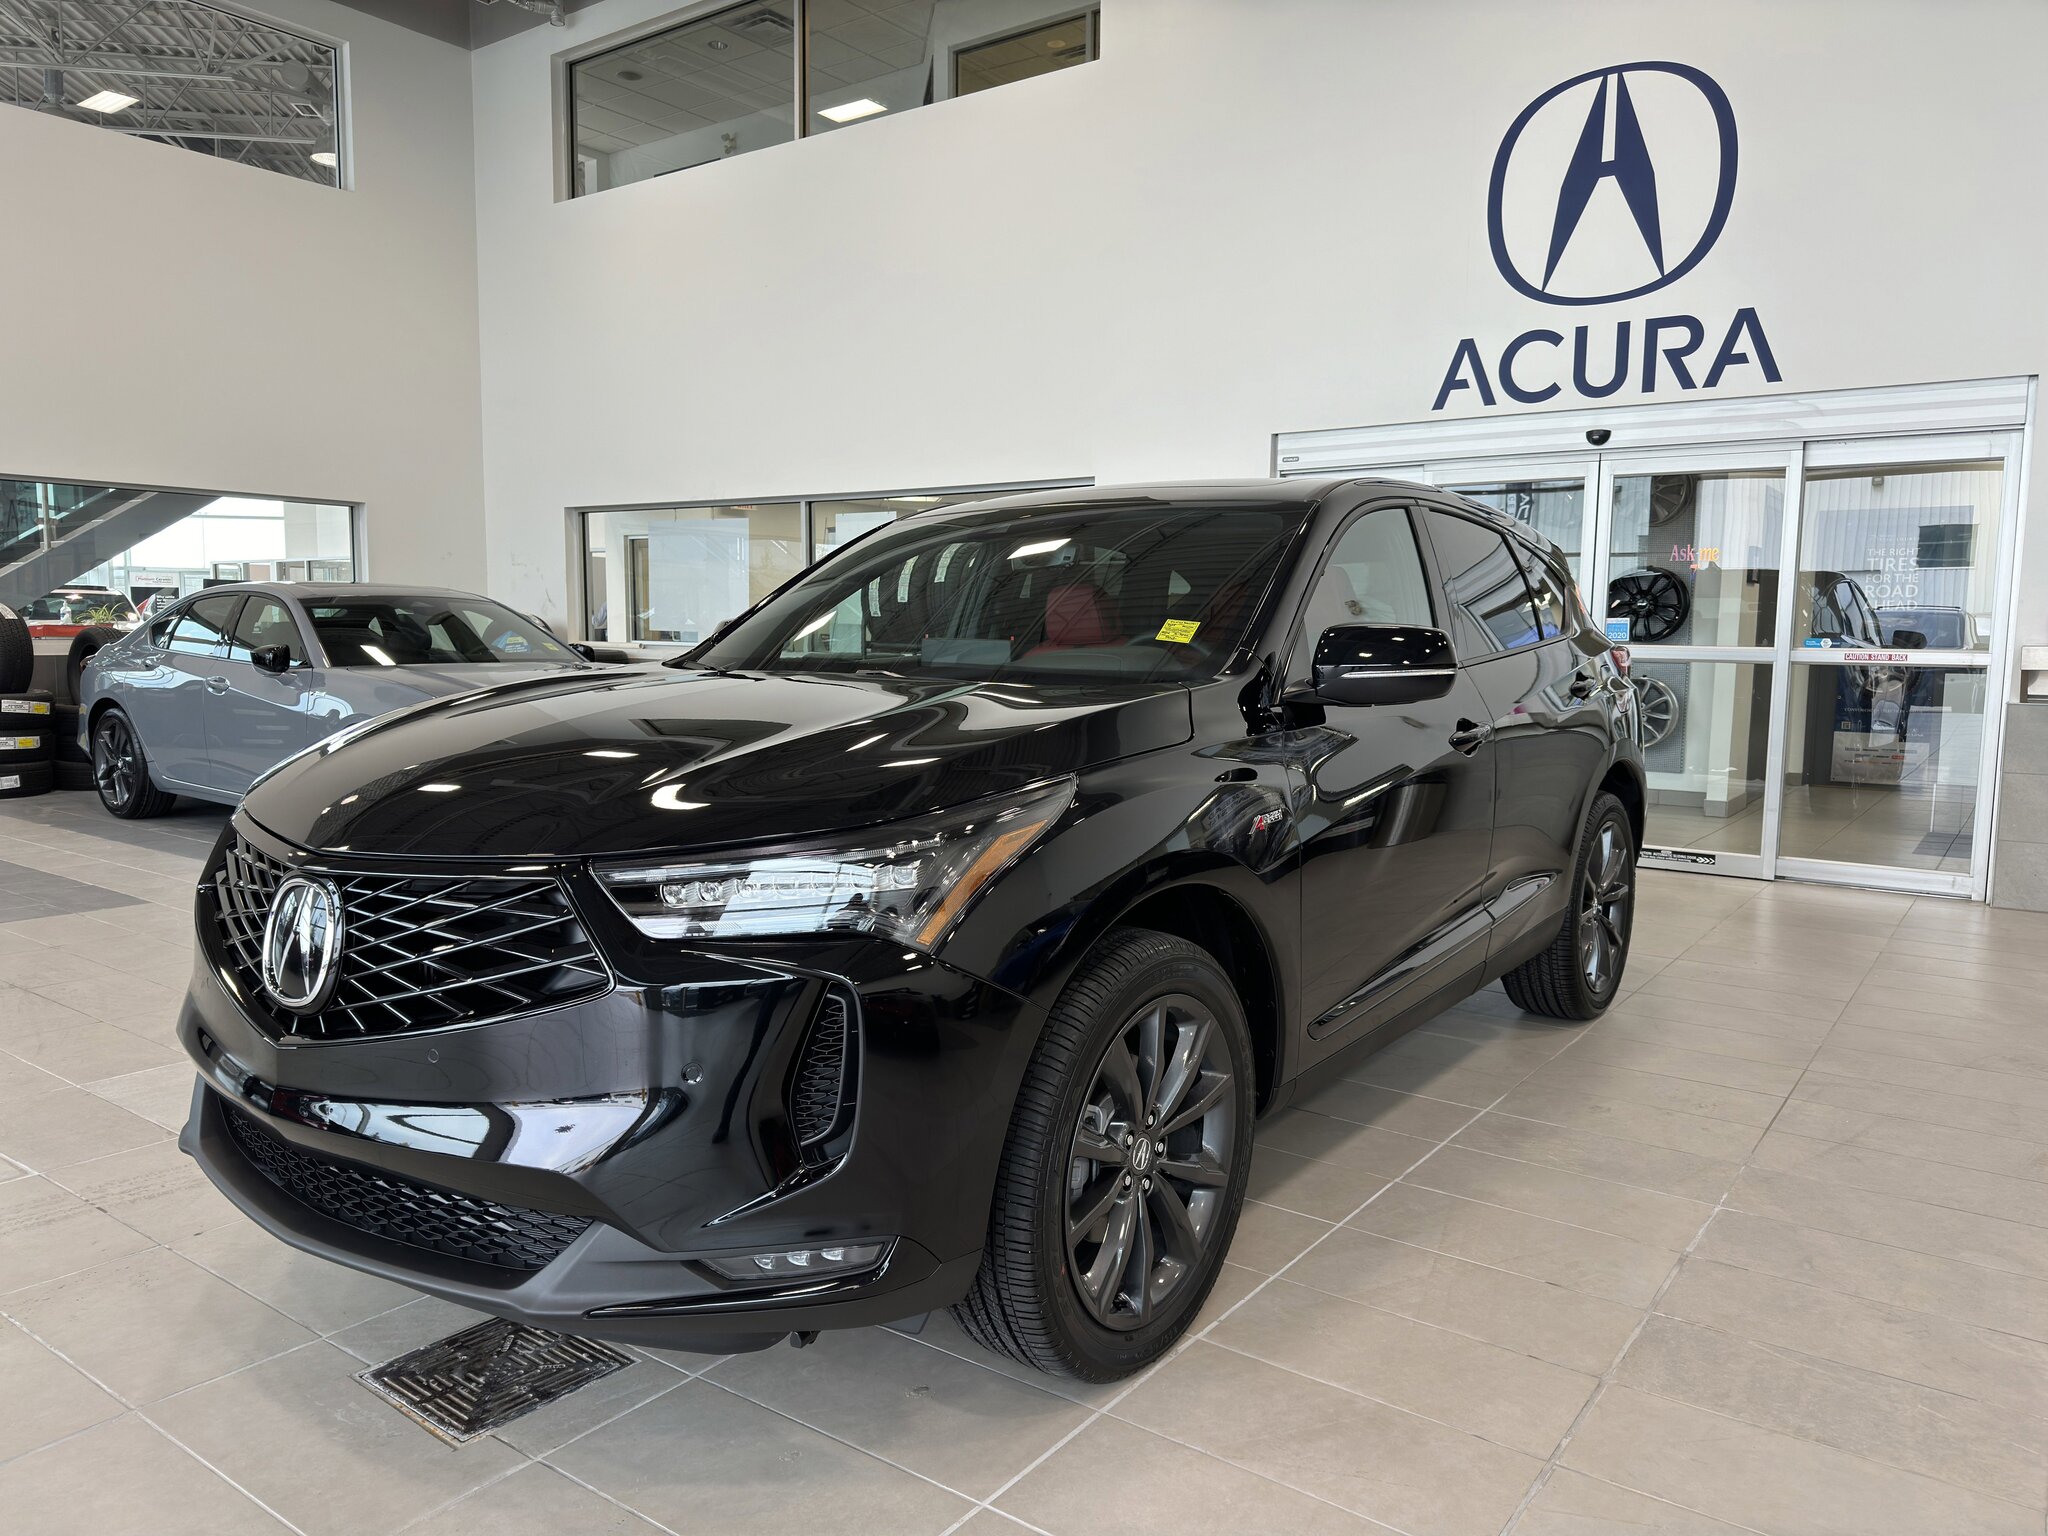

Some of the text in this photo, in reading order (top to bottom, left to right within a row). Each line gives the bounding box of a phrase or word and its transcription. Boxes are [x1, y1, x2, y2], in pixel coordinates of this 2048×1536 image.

[1431, 307, 1783, 411] ACURA
[1669, 544, 1719, 562] Ask me
[1868, 547, 1920, 556] THE RIGHT
[1867, 557, 1919, 572] TIRES
[1865, 573, 1919, 583] FOR THE
[1865, 584, 1918, 598] ROAD
[1863, 599, 1918, 611] AHEAD
[1870, 653, 1889, 661] STAND
[1891, 653, 1907, 661] BACK
